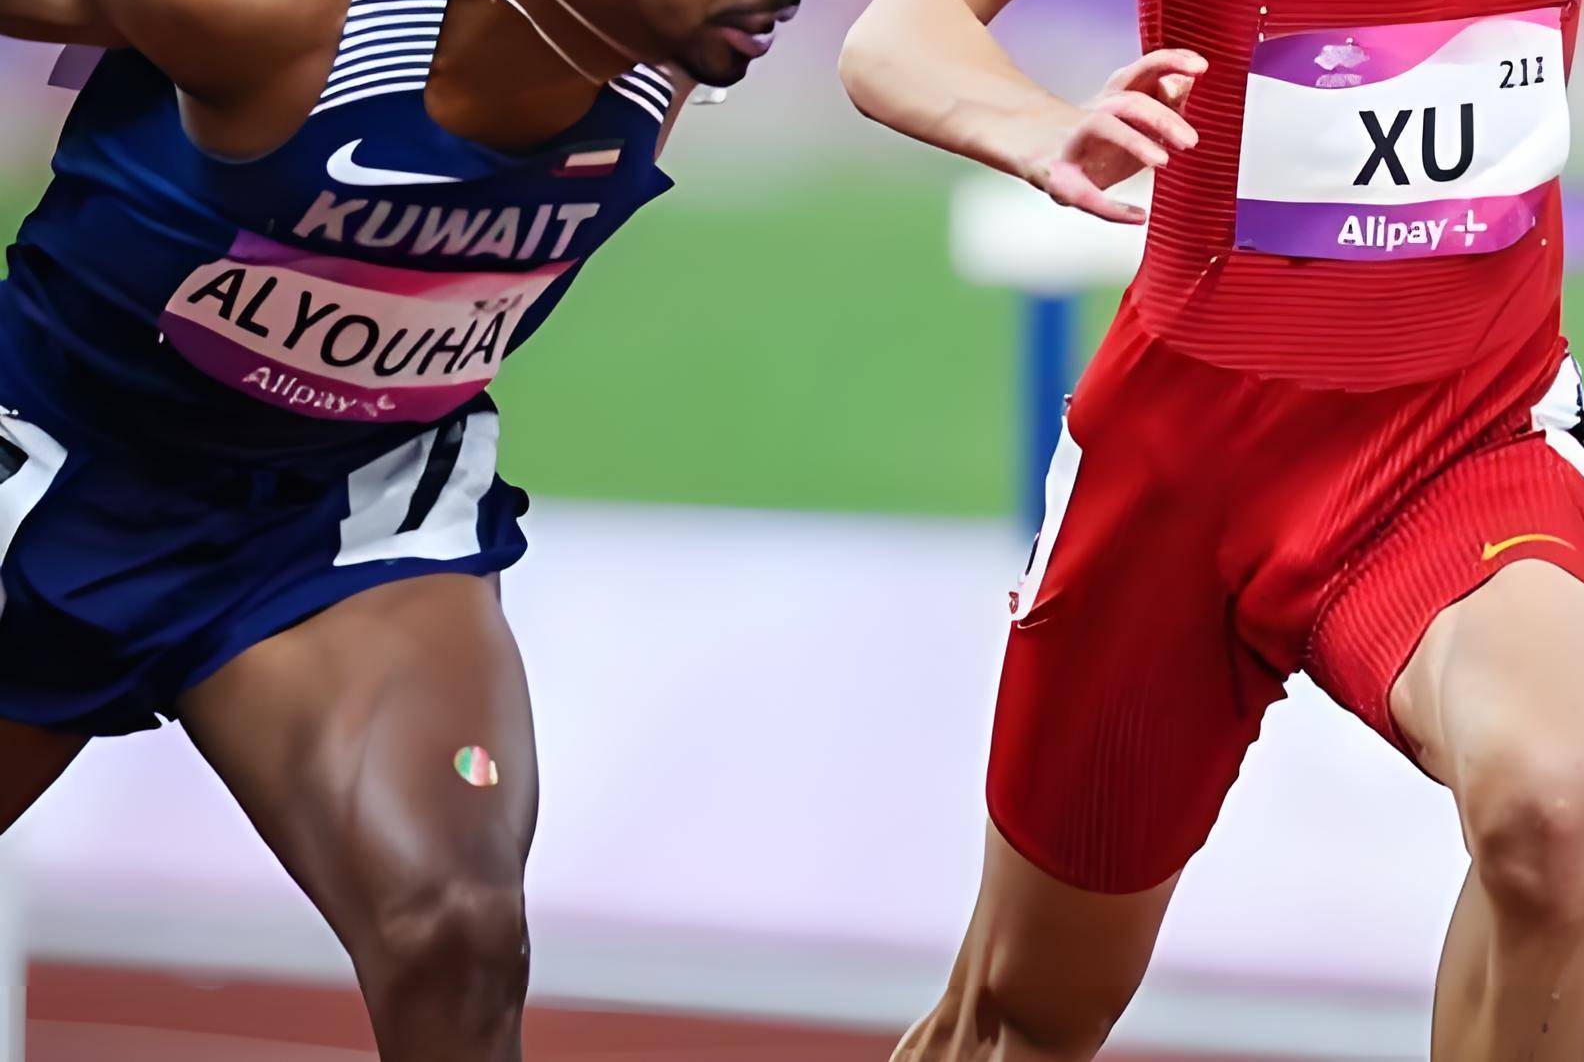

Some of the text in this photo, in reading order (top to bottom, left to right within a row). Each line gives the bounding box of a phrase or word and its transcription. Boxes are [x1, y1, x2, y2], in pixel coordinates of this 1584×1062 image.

[1352, 102, 1475, 186] XU
[292, 190, 600, 261] KUWAIT
[1337, 215, 1448, 252] Alipay
[187, 268, 507, 377] ALYOUHA
